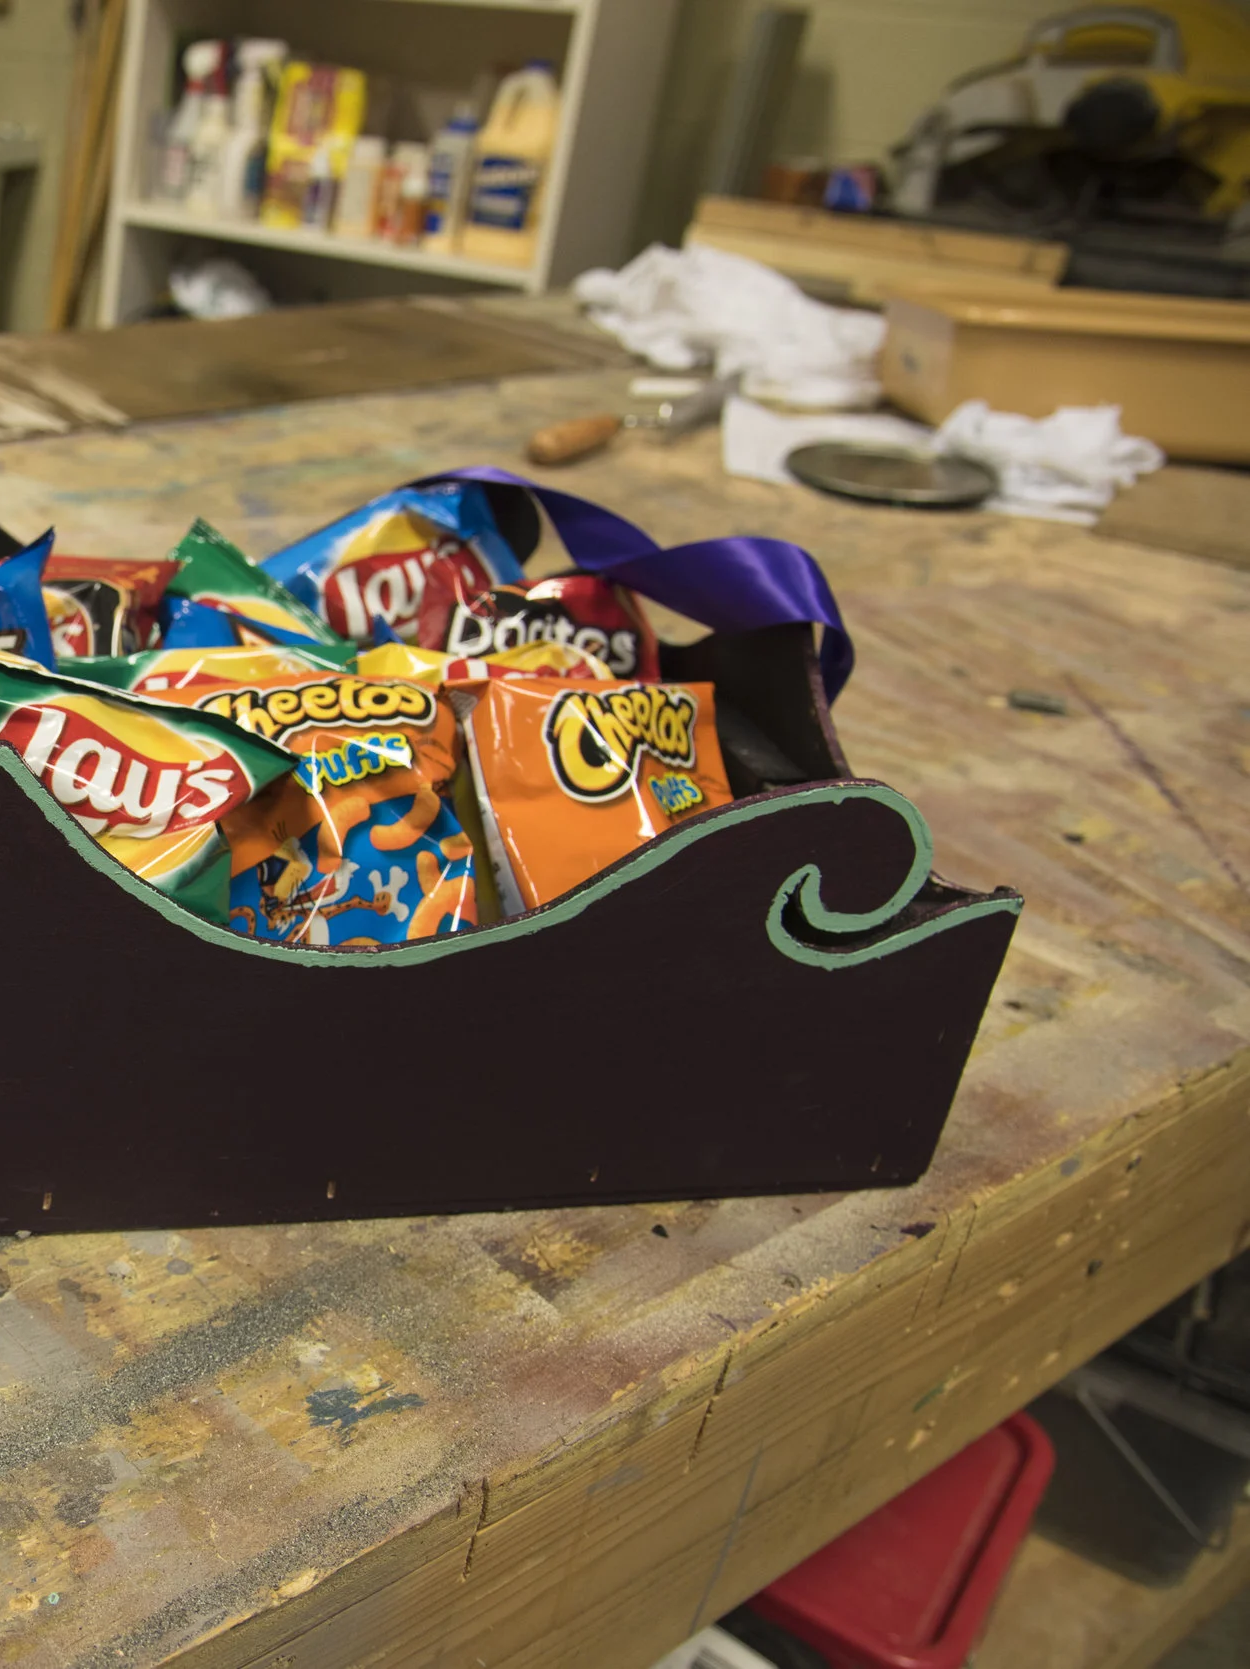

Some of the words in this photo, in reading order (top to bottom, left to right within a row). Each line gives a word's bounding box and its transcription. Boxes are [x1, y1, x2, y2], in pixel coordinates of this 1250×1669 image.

[447, 600, 637, 674] Doritos
[23, 707, 235, 838] Lay's
[296, 735, 408, 791] Puffs
[552, 684, 694, 793] Cheetos
